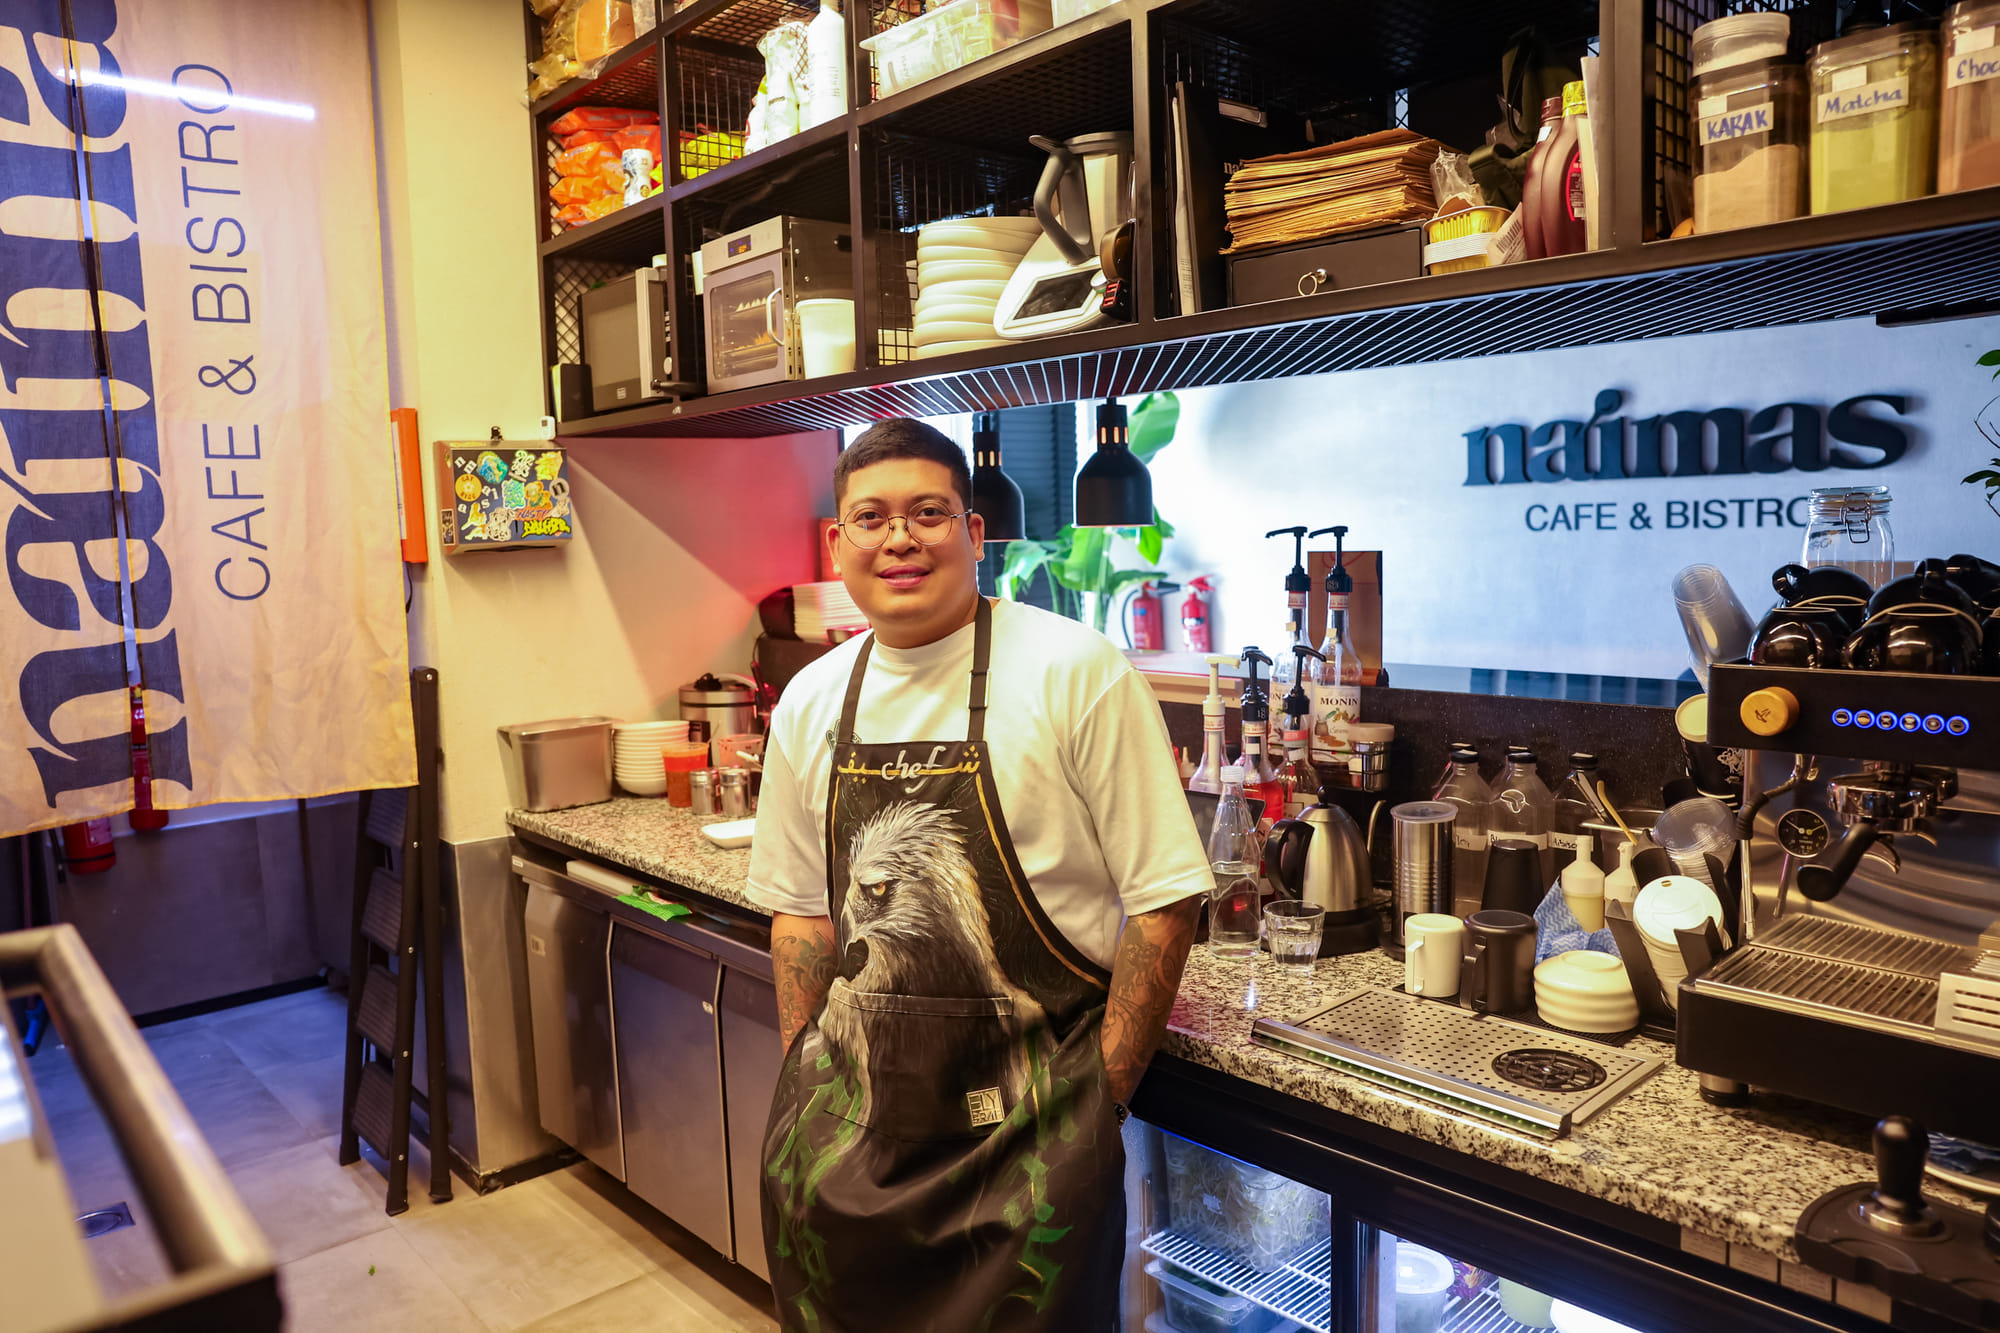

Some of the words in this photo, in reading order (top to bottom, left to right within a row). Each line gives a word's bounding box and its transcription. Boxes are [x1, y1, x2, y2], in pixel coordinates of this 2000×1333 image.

[1823, 88, 1903, 119] Matcha
[1707, 109, 1769, 140] KARAK
[172, 63, 251, 325] BISTRO
[198, 355, 257, 396] &
[1462, 388, 1909, 487] naimas
[203, 423, 271, 600] CAFE
[1524, 502, 1618, 532] CAFE
[1628, 501, 1654, 530] &
[1665, 496, 1809, 530] BISTRO
[1319, 696, 1360, 707] MONIN
[837, 744, 981, 784] شيف
[881, 745, 946, 794] chef
